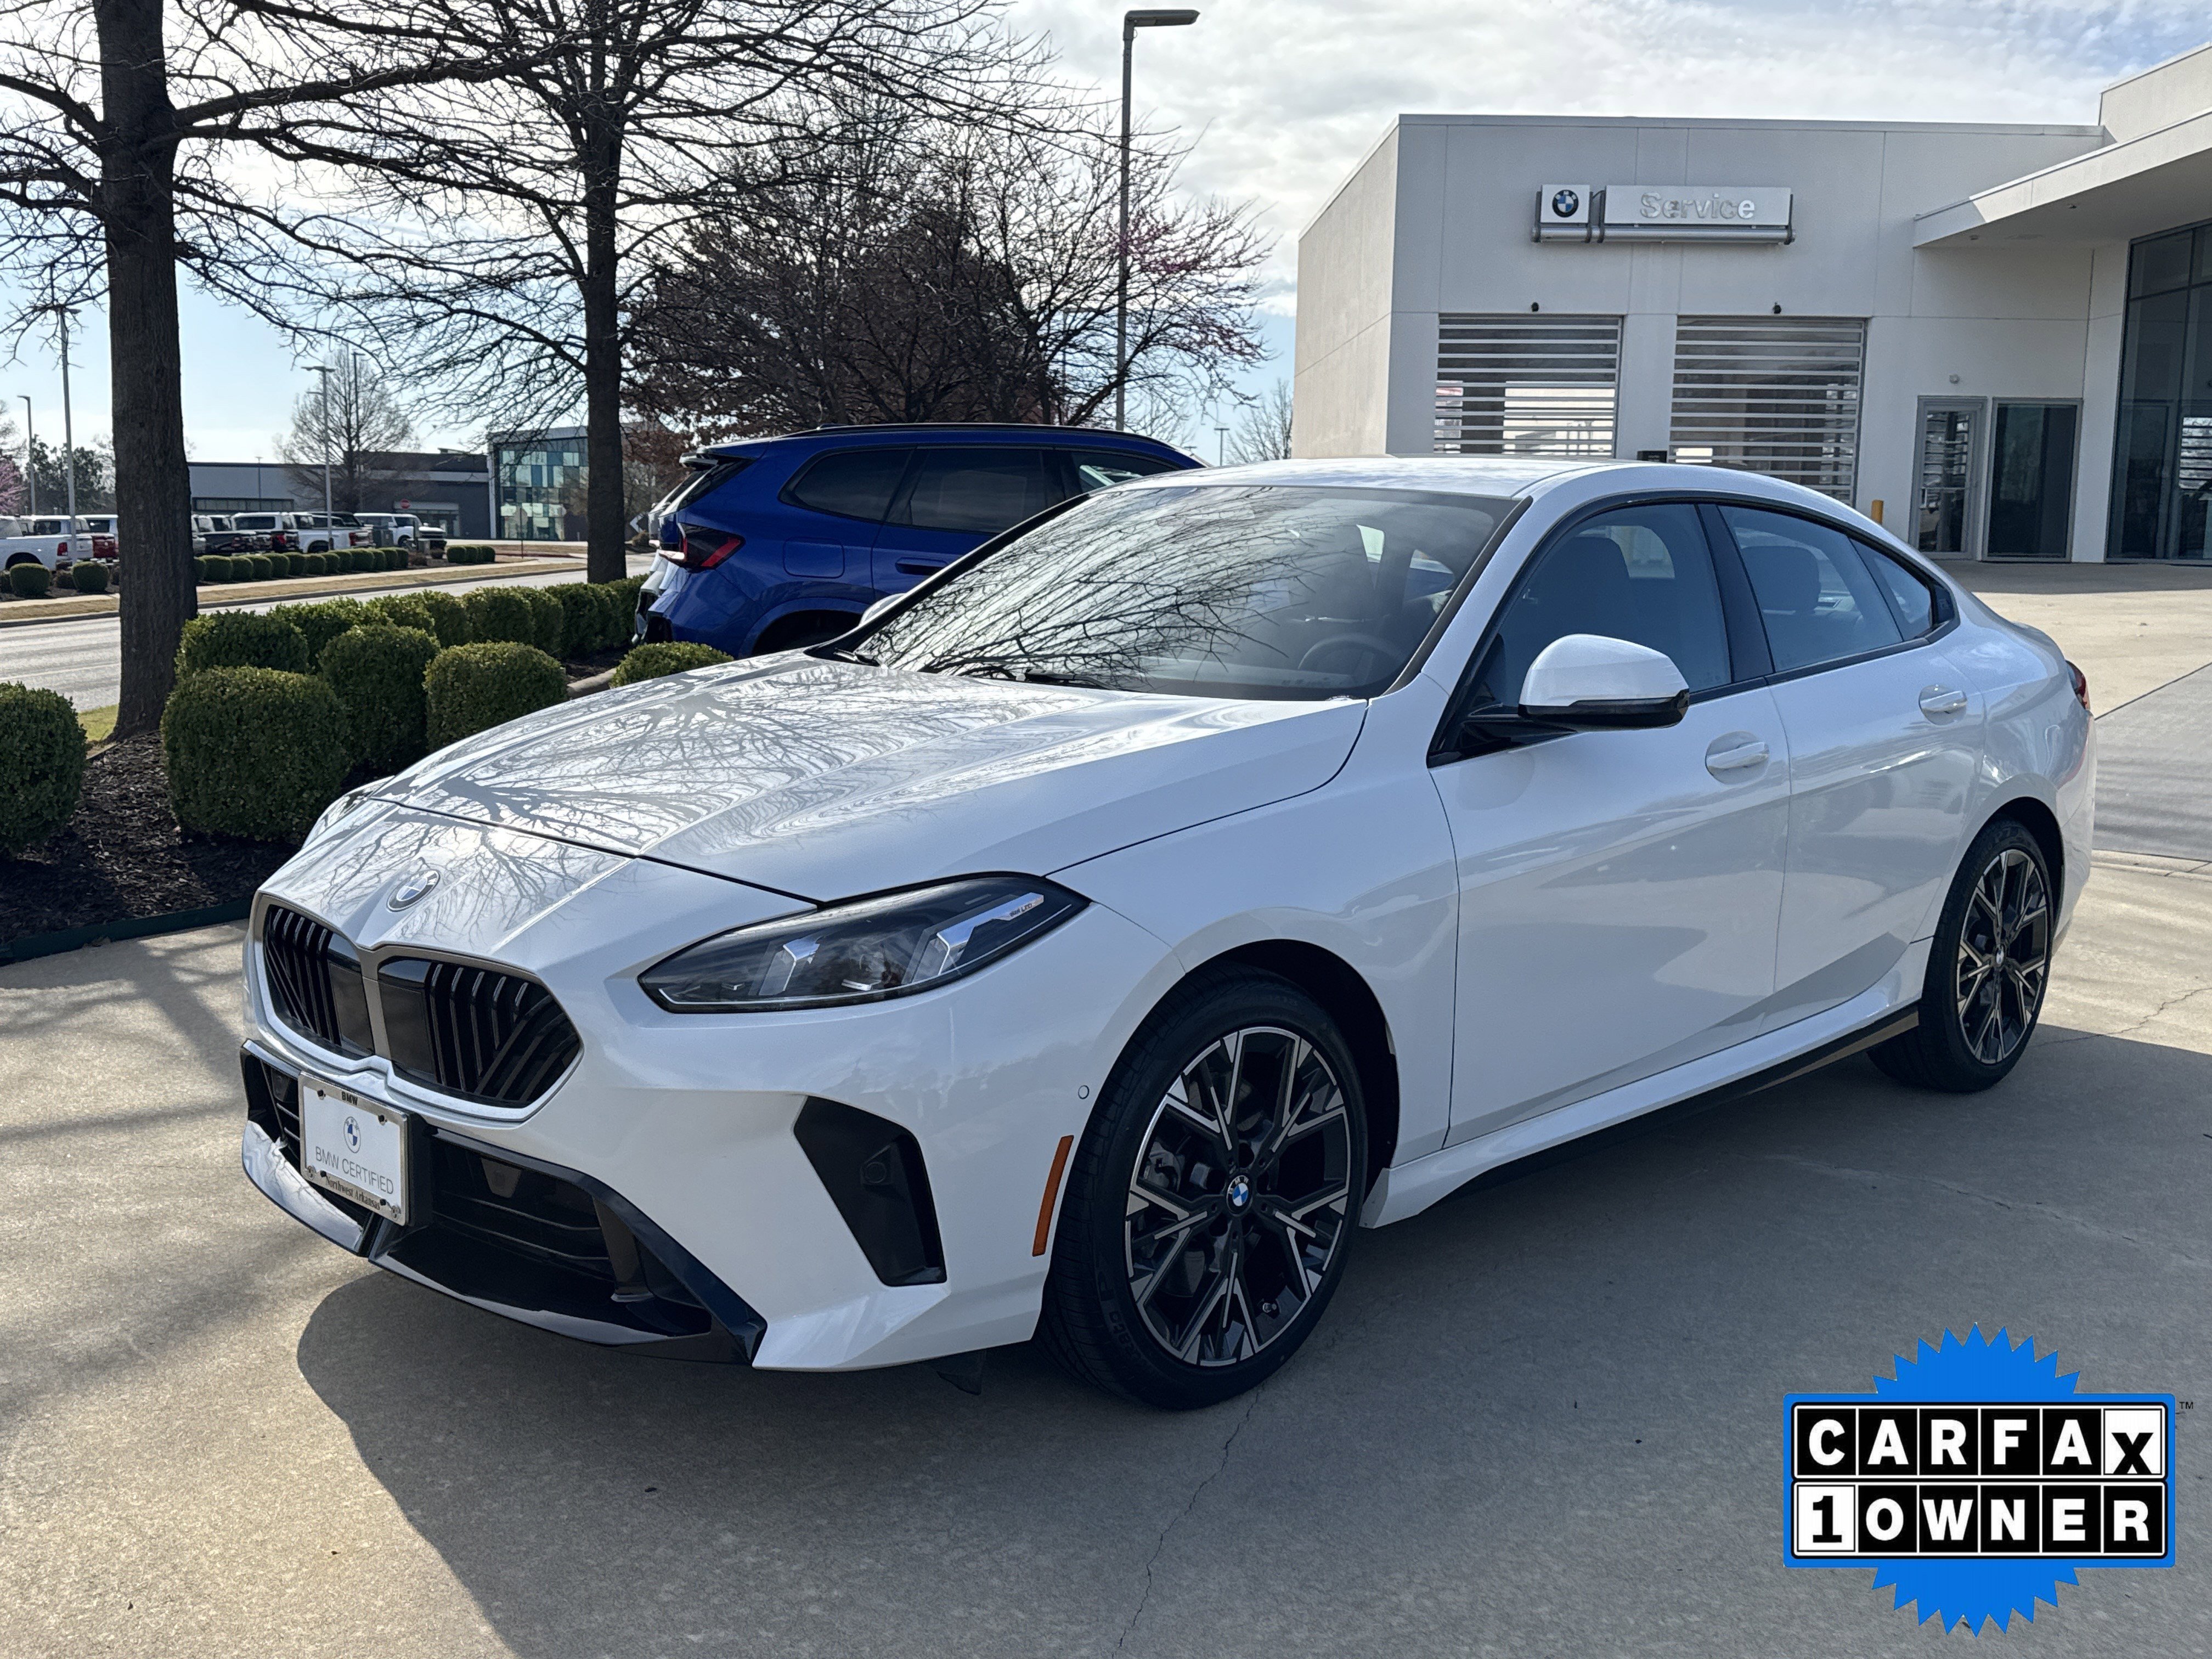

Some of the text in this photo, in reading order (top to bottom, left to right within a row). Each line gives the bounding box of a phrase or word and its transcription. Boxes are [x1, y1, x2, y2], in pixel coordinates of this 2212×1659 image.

[1640, 192, 1755, 219] Service
[342, 1091, 358, 1105] BMW
[315, 1146, 394, 1194] BMW CERTIFIED
[325, 1175, 380, 1210] Northwest Arkansas
